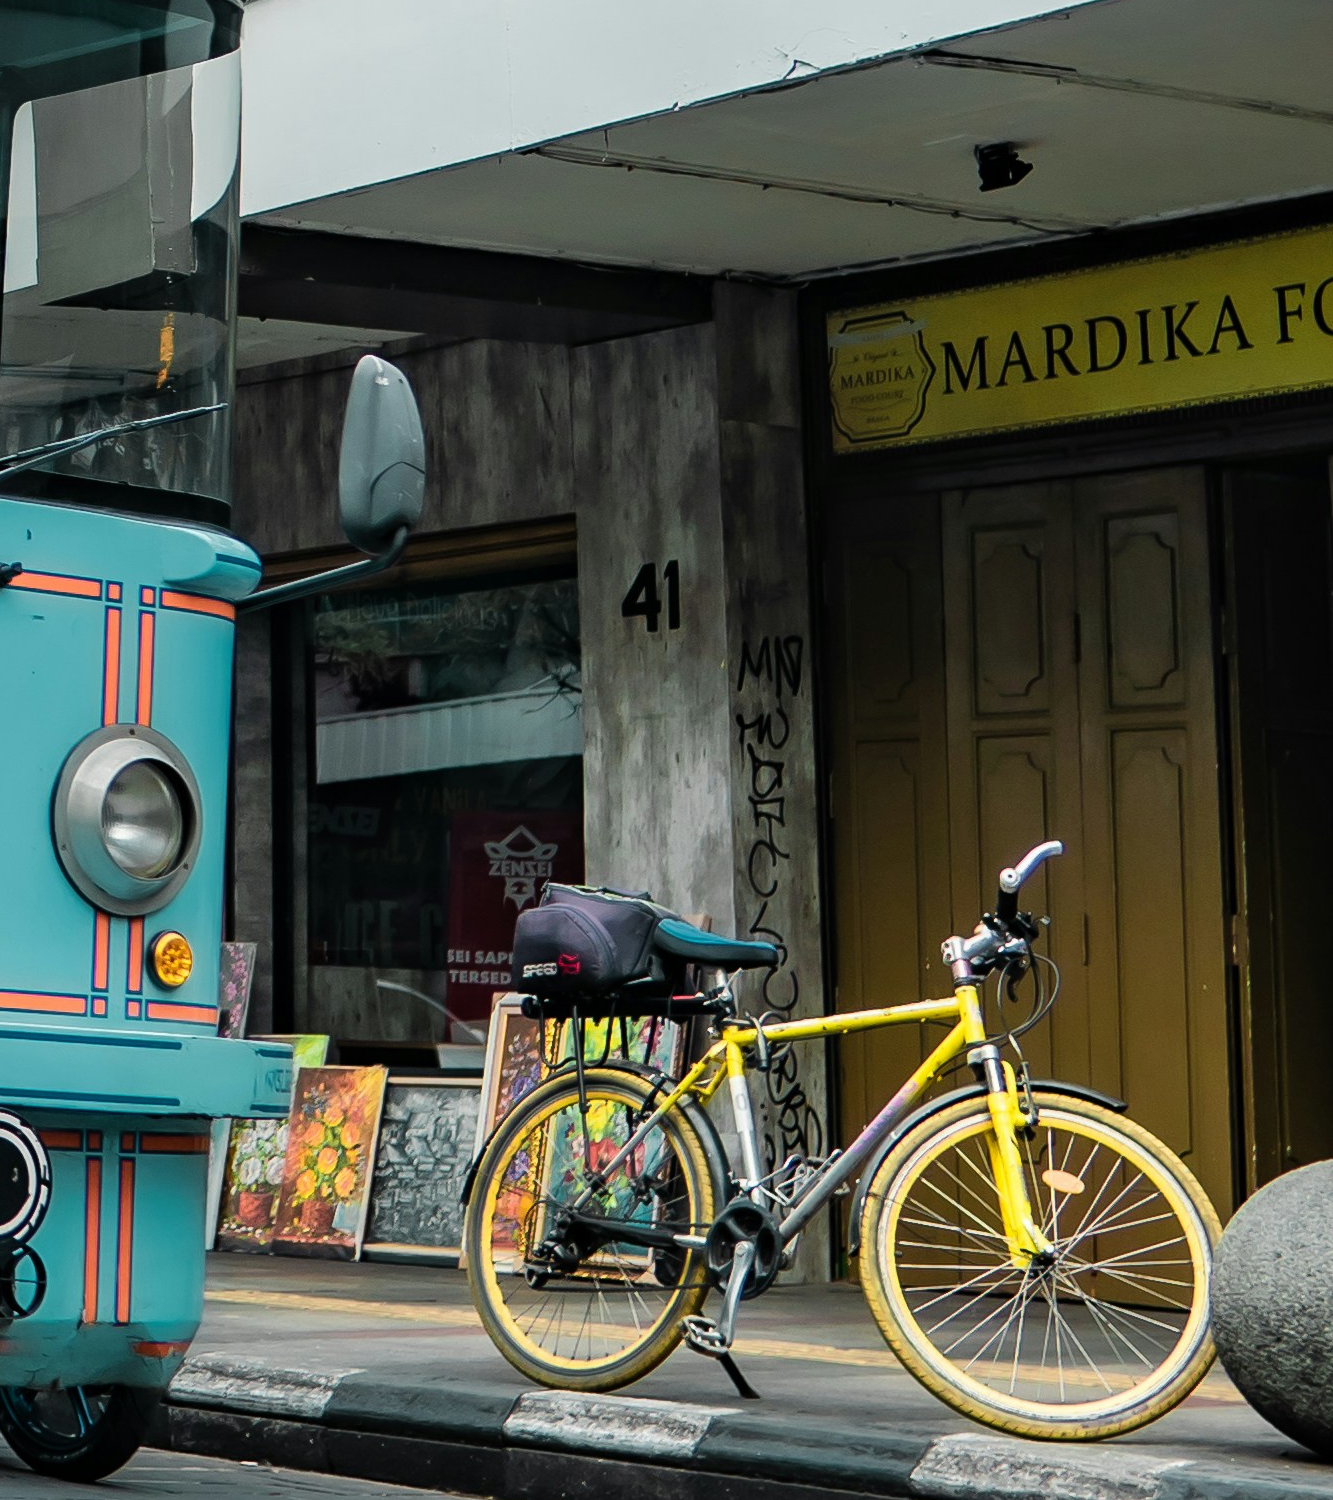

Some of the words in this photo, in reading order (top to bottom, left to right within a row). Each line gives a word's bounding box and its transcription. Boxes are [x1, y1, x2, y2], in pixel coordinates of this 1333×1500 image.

[940, 294, 1255, 396] MARDIKA
[839, 365, 915, 391] MARDIKA
[621, 559, 681, 633] 41
[488, 860, 553, 878] ZENSEI
